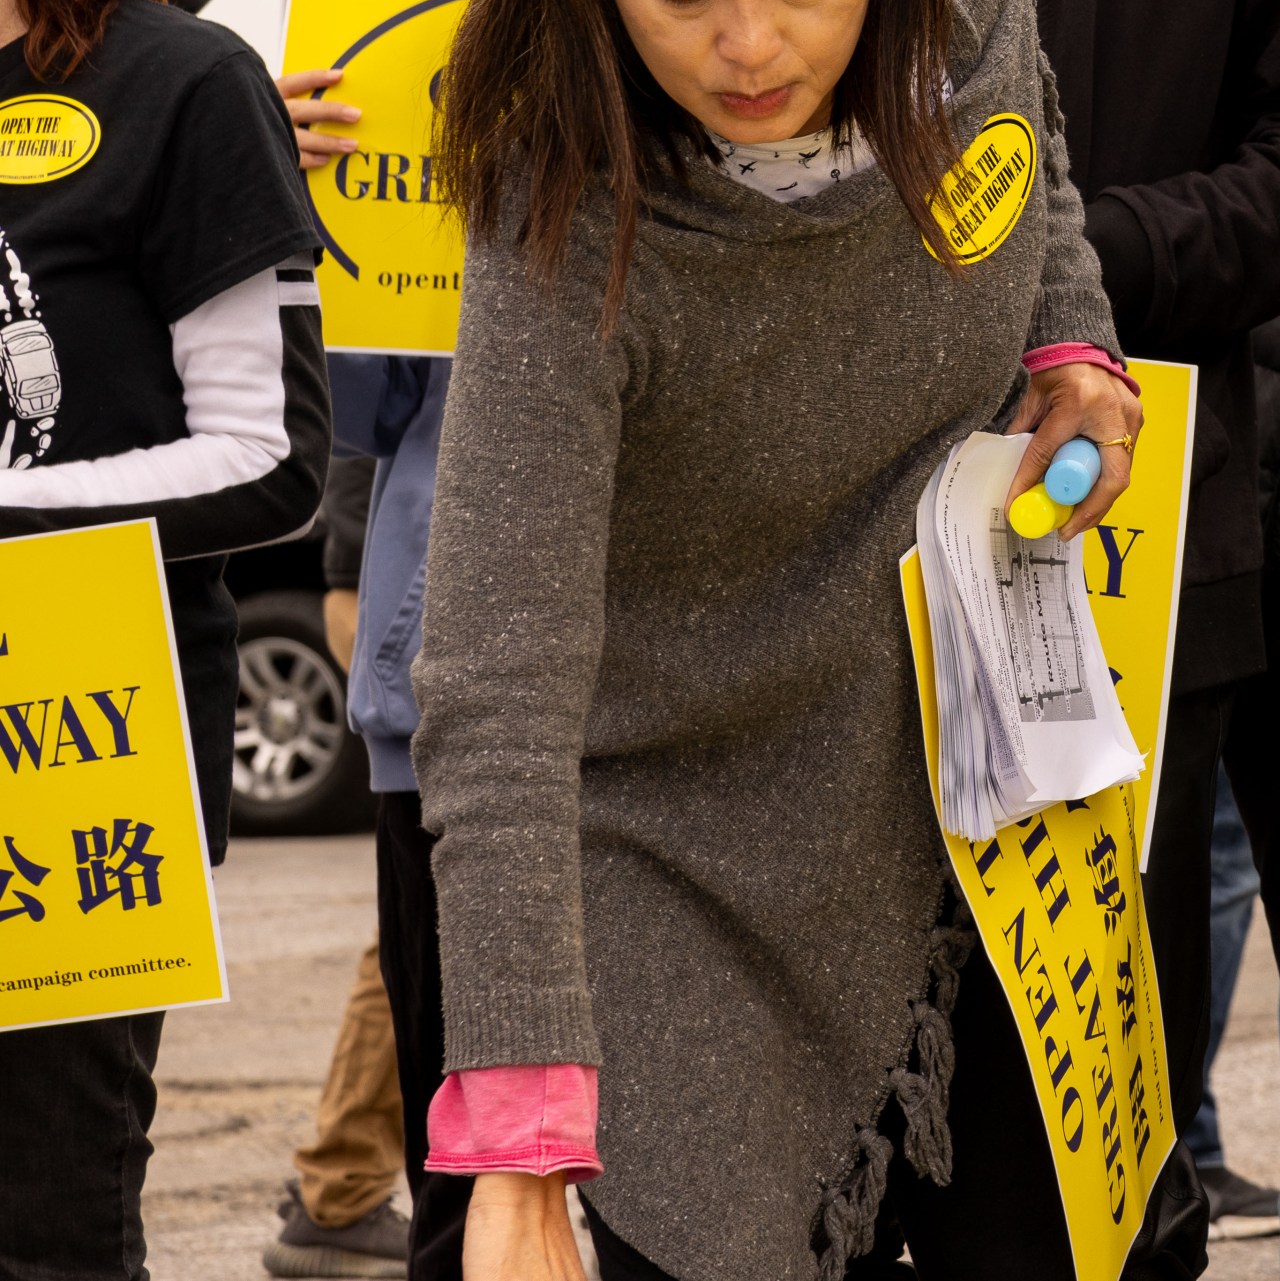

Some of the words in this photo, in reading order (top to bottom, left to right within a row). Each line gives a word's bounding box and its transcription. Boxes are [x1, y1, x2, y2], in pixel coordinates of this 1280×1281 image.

[1, 117, 34, 134] OPEN
[36, 116, 61, 133] THE
[16, 140, 76, 157] HIGHWAY
[950, 167, 983, 208] OPEN
[976, 143, 1002, 178] THE
[949, 202, 987, 249] GREAT
[980, 147, 1026, 213] HIGHWAY
[1033, 571, 1043, 617] Map
[1041, 623, 1054, 683] Route
[0, 970, 83, 992] campaign
[88, 958, 191, 980] committee.
[1144, 991, 1152, 1015] an
[1003, 906, 1084, 1154] OPEN
[1147, 1021, 1156, 1043] by
[1151, 1049, 1160, 1076] for
[1064, 949, 1126, 1225] GREAT
[1154, 1082, 1165, 1124] Paid
